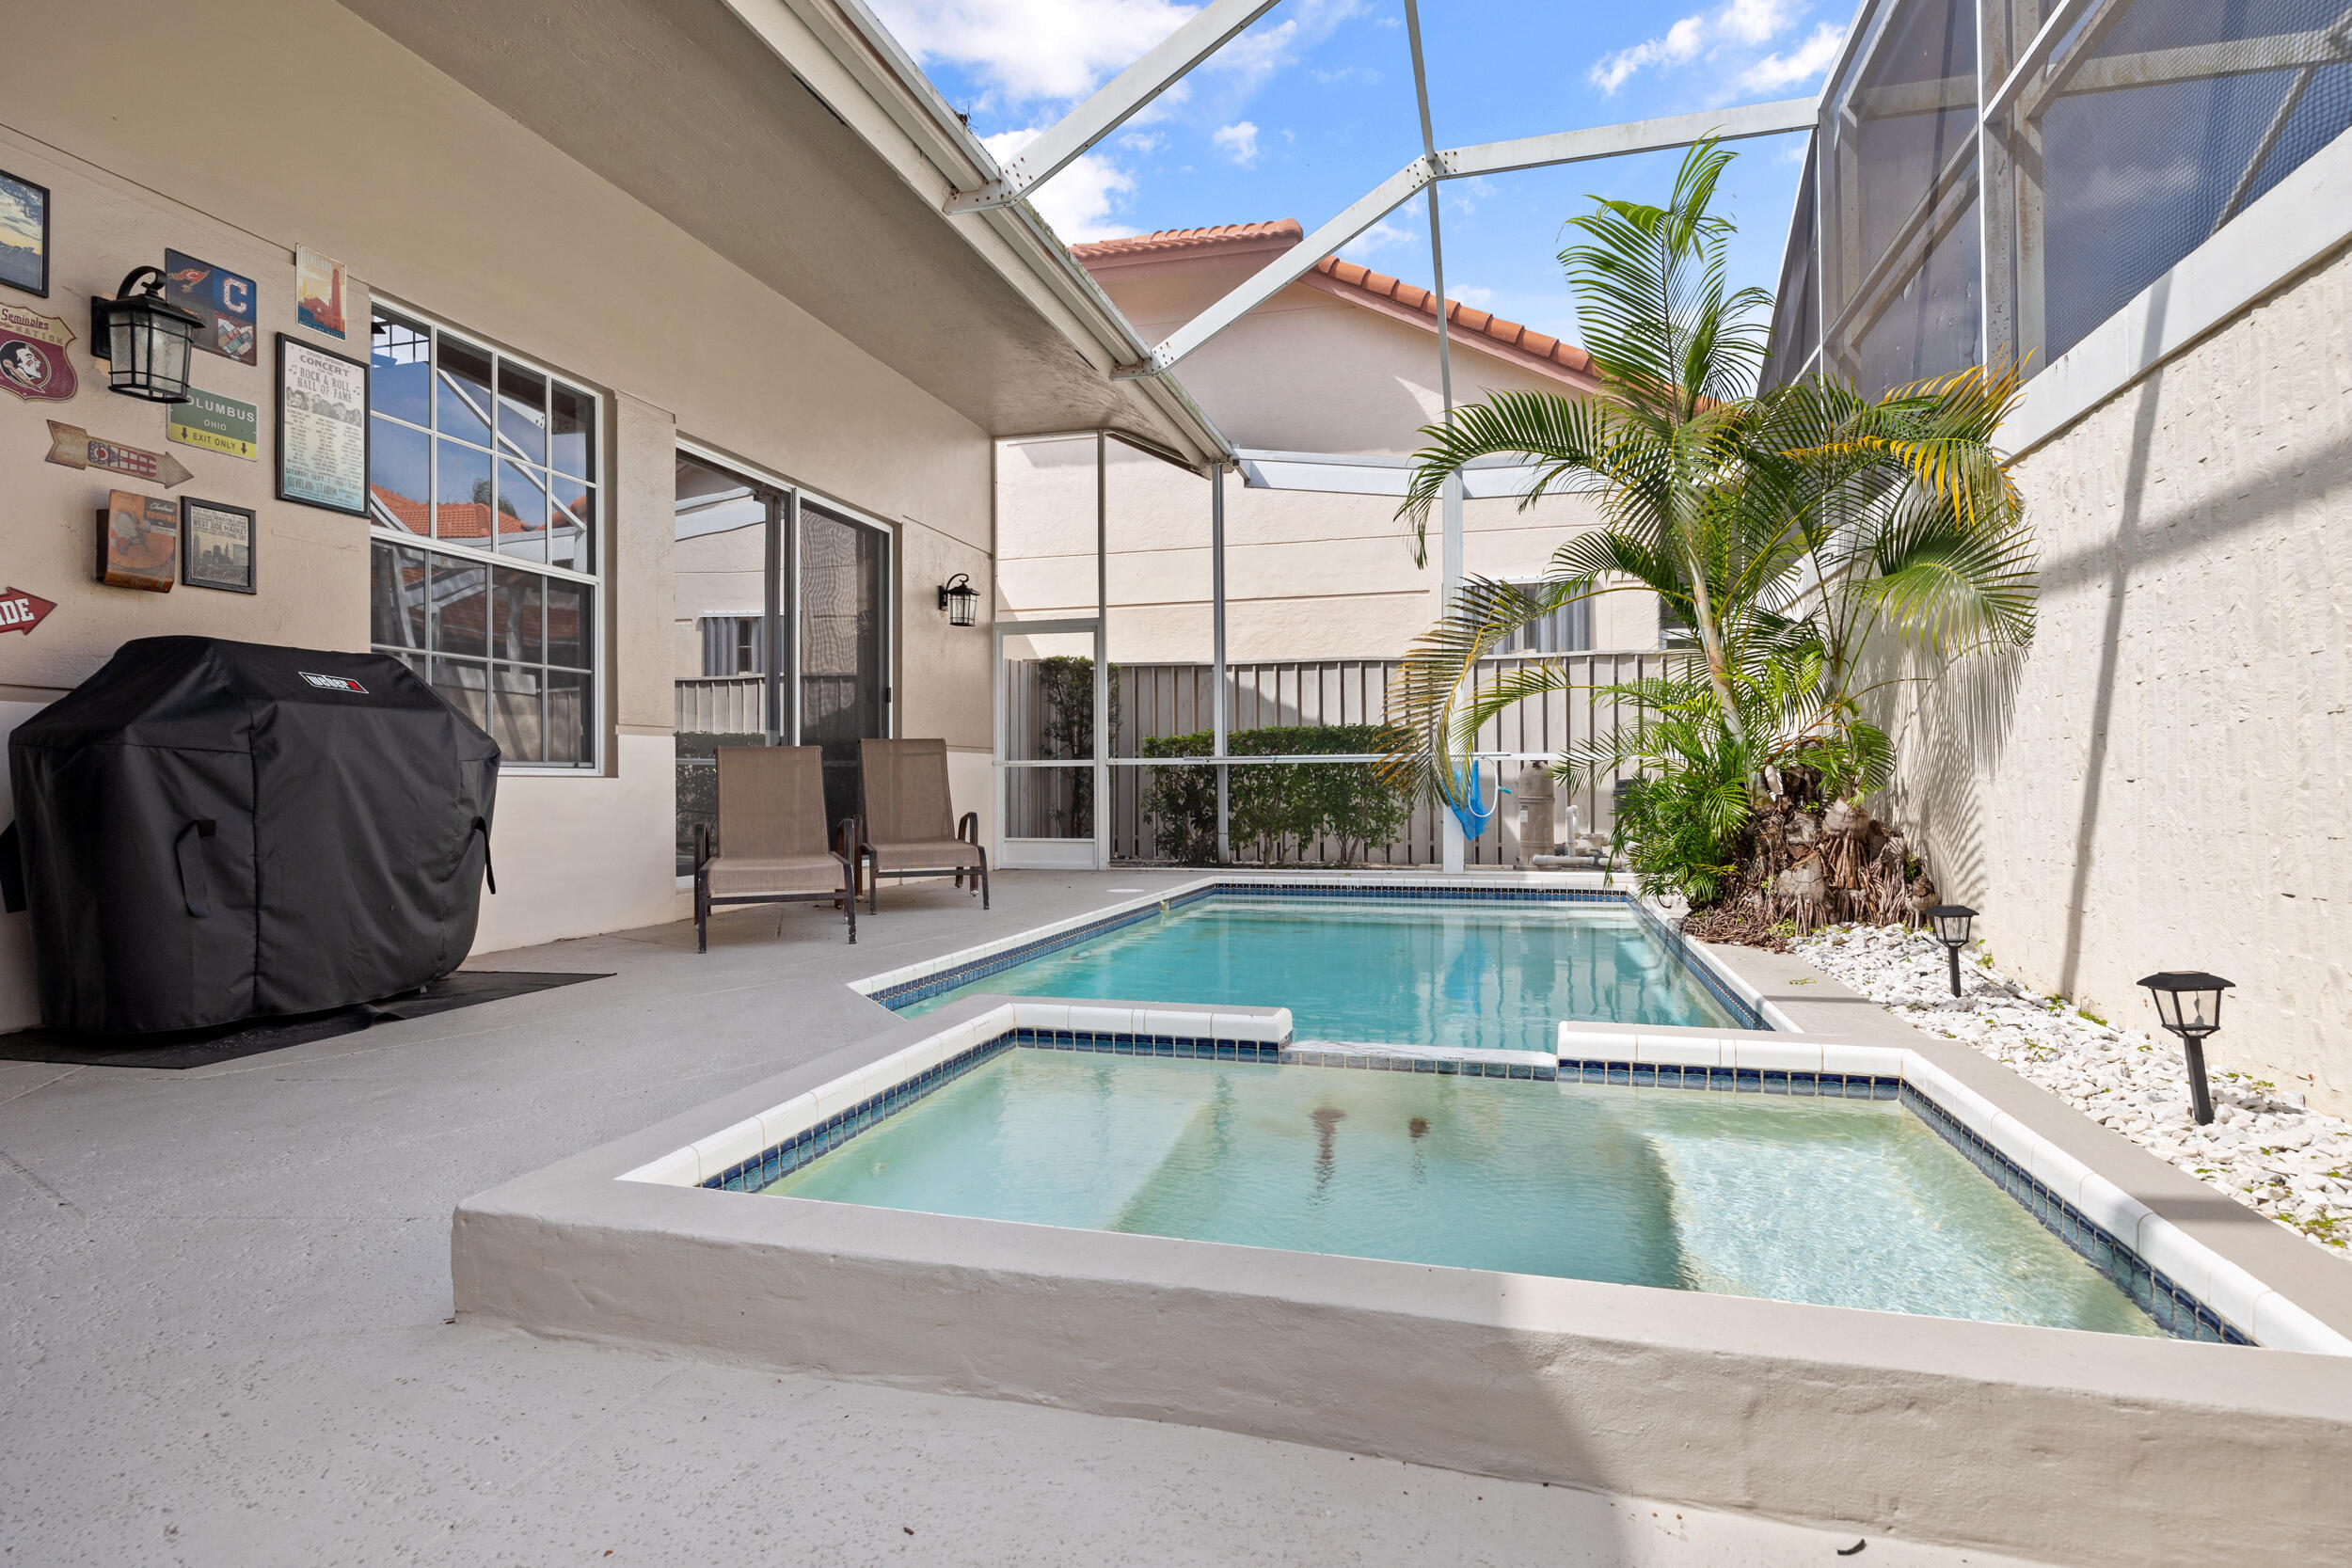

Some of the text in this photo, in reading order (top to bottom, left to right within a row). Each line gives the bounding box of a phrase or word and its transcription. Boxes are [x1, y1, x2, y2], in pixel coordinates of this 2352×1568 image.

[223, 277, 247, 314] C
[1, 309, 49, 330] Seminoles
[15, 325, 63, 345] NATION
[300, 355, 350, 376] CONCERT
[297, 376, 352, 404] HALL OF FAME
[300, 367, 320, 383] ROCK
[332, 377, 350, 392] ROLL
[186, 395, 255, 422] OLUMBUS
[203, 419, 227, 431] OHIO
[193, 432, 236, 450] EXIT ONLY
